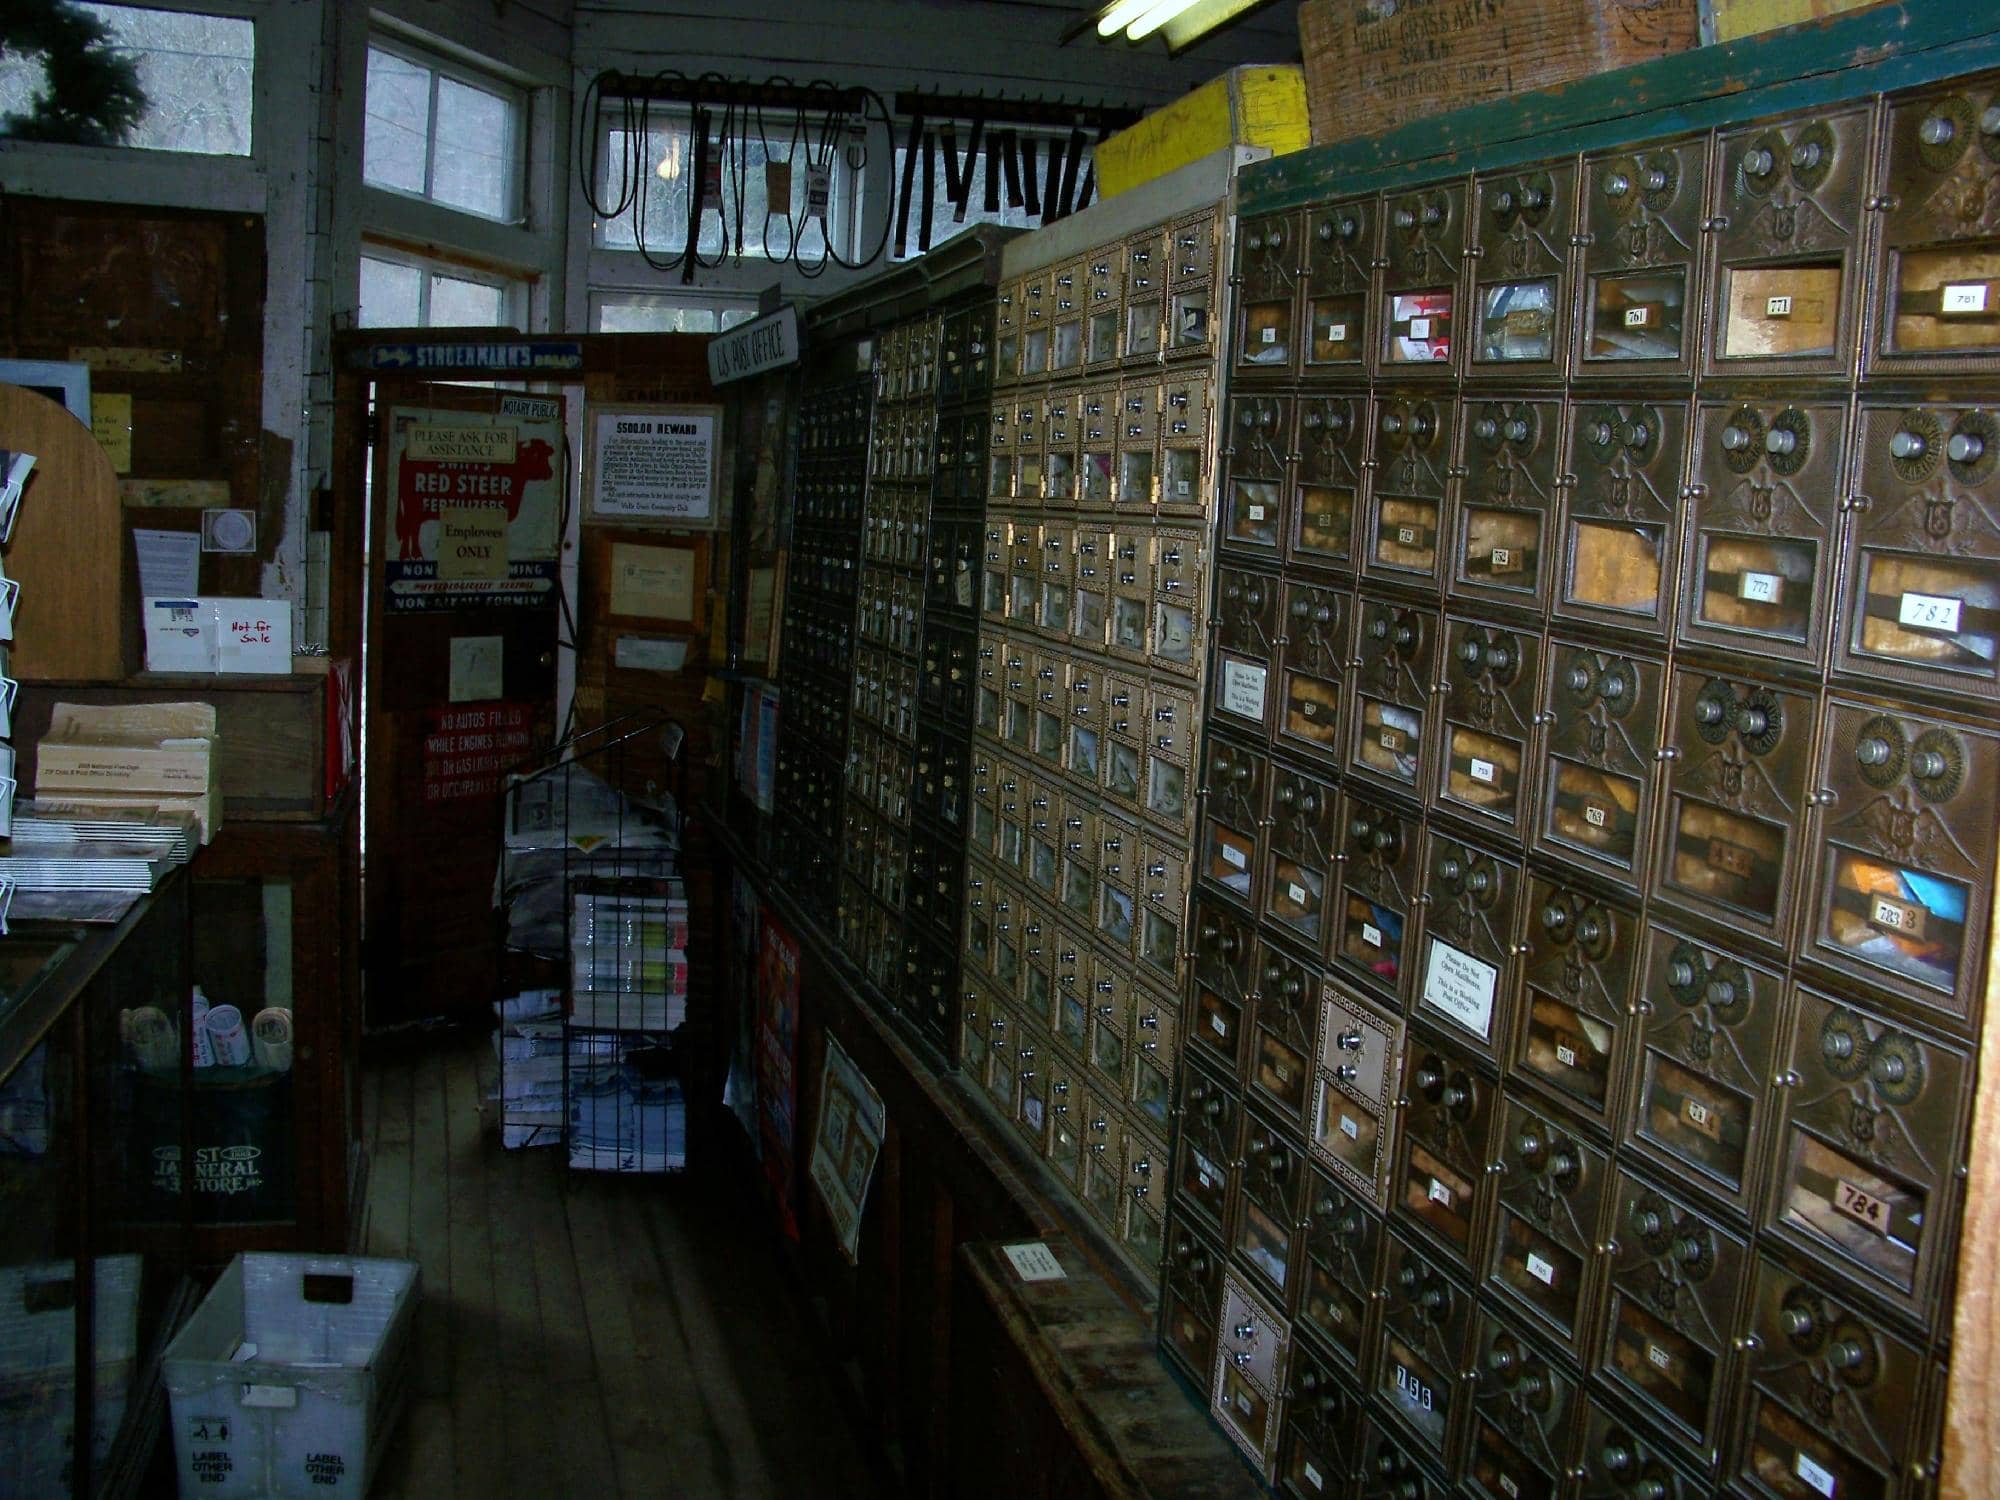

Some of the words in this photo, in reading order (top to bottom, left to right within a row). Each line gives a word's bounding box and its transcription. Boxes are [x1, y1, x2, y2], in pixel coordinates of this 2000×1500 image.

[1771, 300, 1788, 312] 771
[1956, 295, 1977, 305] 781
[1628, 310, 1644, 323] 761
[751, 319, 785, 366] OFFICE
[503, 399, 530, 416] NOTARY
[532, 401, 558, 417] PUBLIC
[656, 423, 697, 435] REWARD
[415, 431, 456, 442] PLEASE
[459, 432, 481, 443] ASK
[484, 432, 509, 444] FOR
[428, 443, 495, 457] ASSISTANCE
[415, 472, 449, 494] RED
[457, 474, 512, 496] STEER
[445, 525, 502, 539] Employees
[456, 546, 491, 559] ONLY
[402, 564, 434, 576] NON
[1753, 579, 1770, 594] 772
[1912, 603, 1953, 624] 782
[232, 621, 250, 633] Not
[253, 620, 272, 632] for
[240, 633, 271, 643] Sale
[441, 713, 452, 730] NO
[456, 712, 486, 729] AUTOS
[427, 735, 456, 752] WHILE
[459, 734, 493, 752] ENGINES
[1587, 807, 1604, 824] 763
[1878, 905, 1900, 926] 783
[1441, 961, 1454, 974] Open
[1438, 976, 1448, 989] This
[194, 1160, 261, 1177] NERAL
[193, 1177, 249, 1196] TORE
[1845, 1186, 1880, 1222] 784
[192, 1452, 231, 1462] LABEL
[307, 1453, 344, 1465] LABEL
[192, 1462, 232, 1473] OTHER
[306, 1464, 344, 1475] OTHER
[201, 1473, 225, 1483] END
[312, 1475, 337, 1485] END
